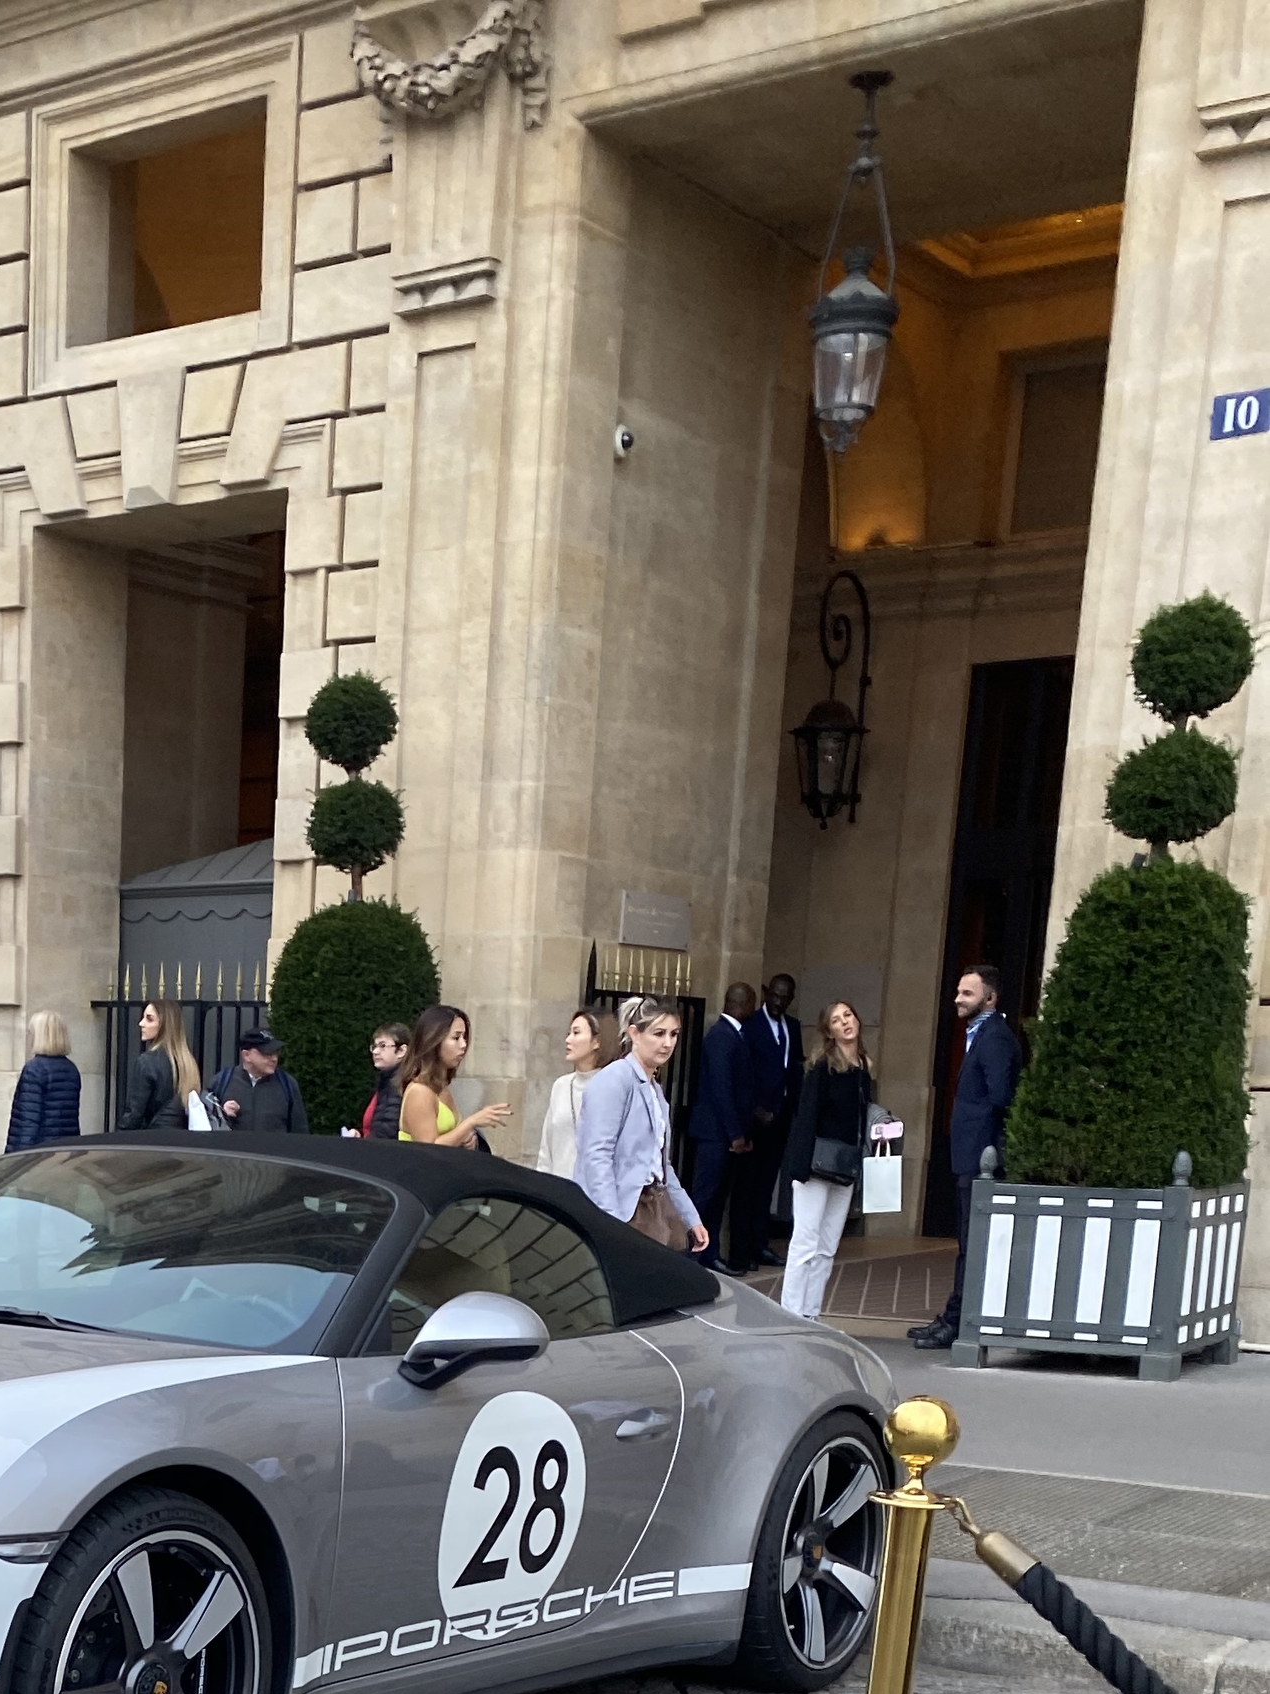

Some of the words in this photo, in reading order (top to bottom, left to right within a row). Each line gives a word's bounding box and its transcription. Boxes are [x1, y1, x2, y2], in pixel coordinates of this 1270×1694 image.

[1222, 395, 1260, 433] 10
[452, 1439, 569, 1589] 28
[334, 1571, 675, 1672] PORSCHE
